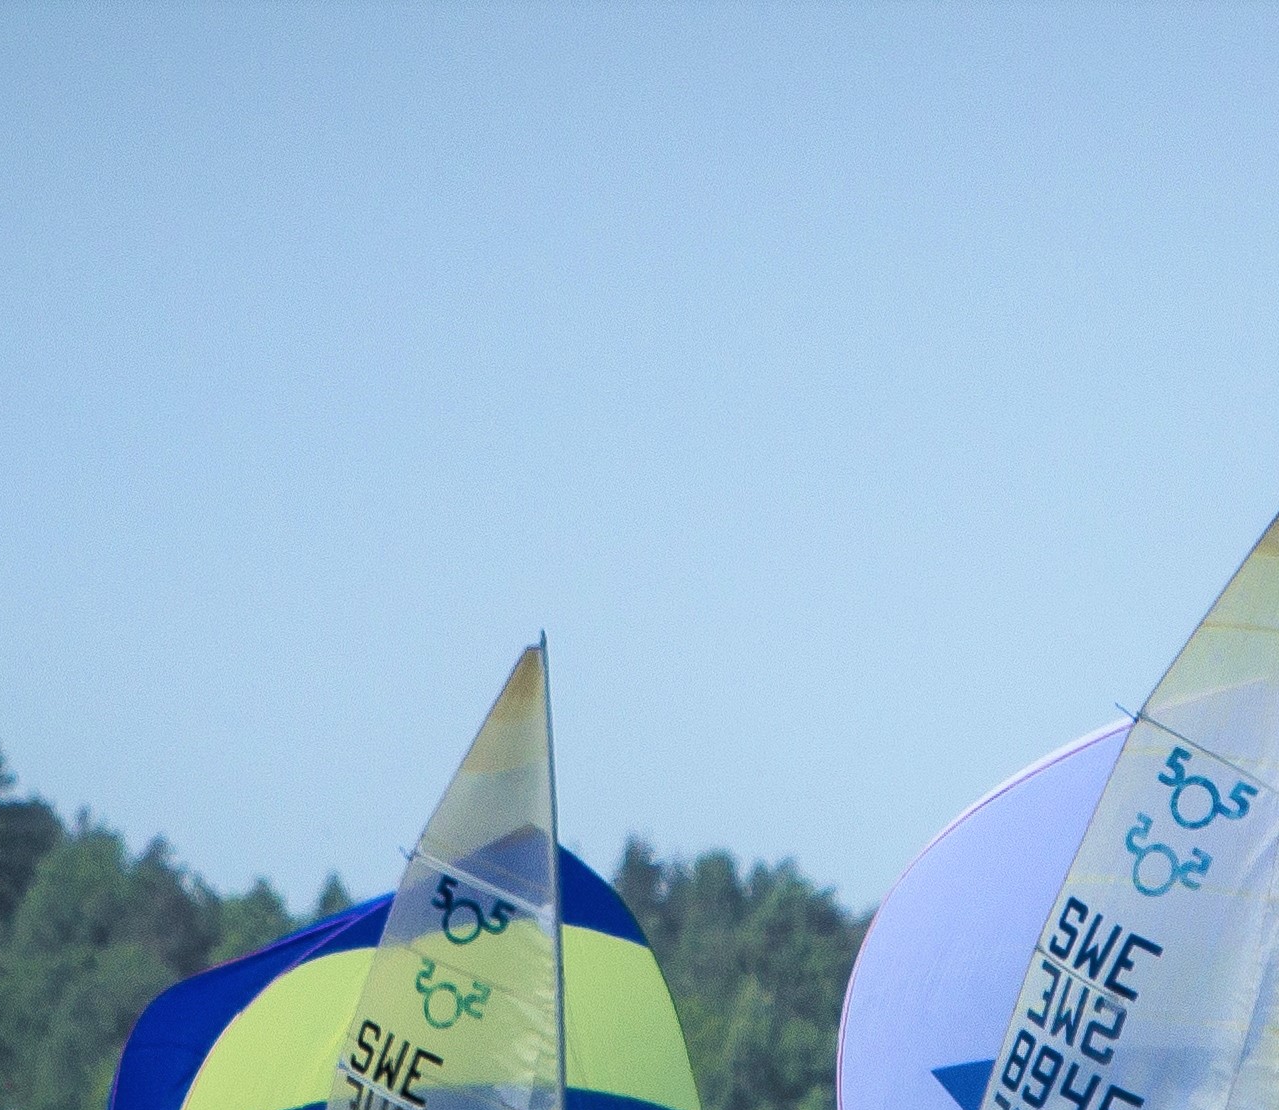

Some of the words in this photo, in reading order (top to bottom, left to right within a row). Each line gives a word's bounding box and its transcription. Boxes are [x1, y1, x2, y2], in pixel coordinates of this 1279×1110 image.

[1158, 747, 1258, 829] 505
[431, 874, 516, 944] 505
[1049, 897, 1163, 1001] SWE
[350, 1020, 444, 1107] SWE
